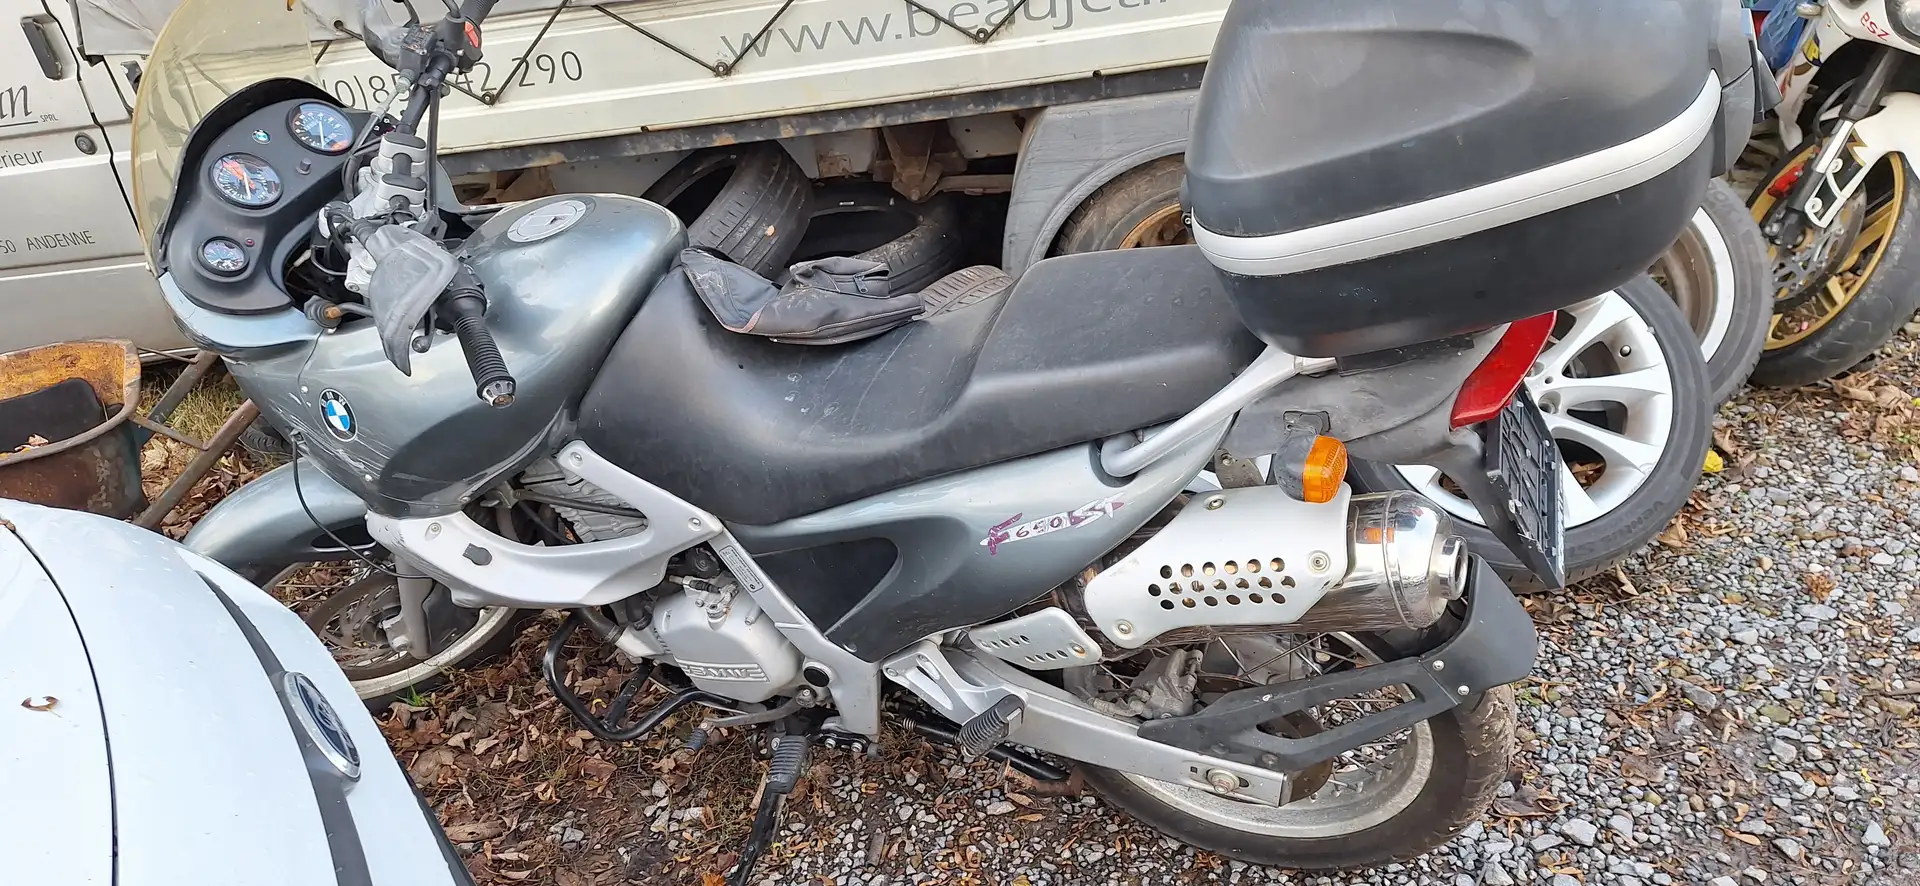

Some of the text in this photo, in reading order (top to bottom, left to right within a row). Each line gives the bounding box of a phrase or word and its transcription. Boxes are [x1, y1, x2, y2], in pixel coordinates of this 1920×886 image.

[511, 50, 583, 88] 290
[39, 113, 59, 122] SPRL
[26, 230, 95, 251] ANDENNE
[689, 665, 747, 678] BMW
